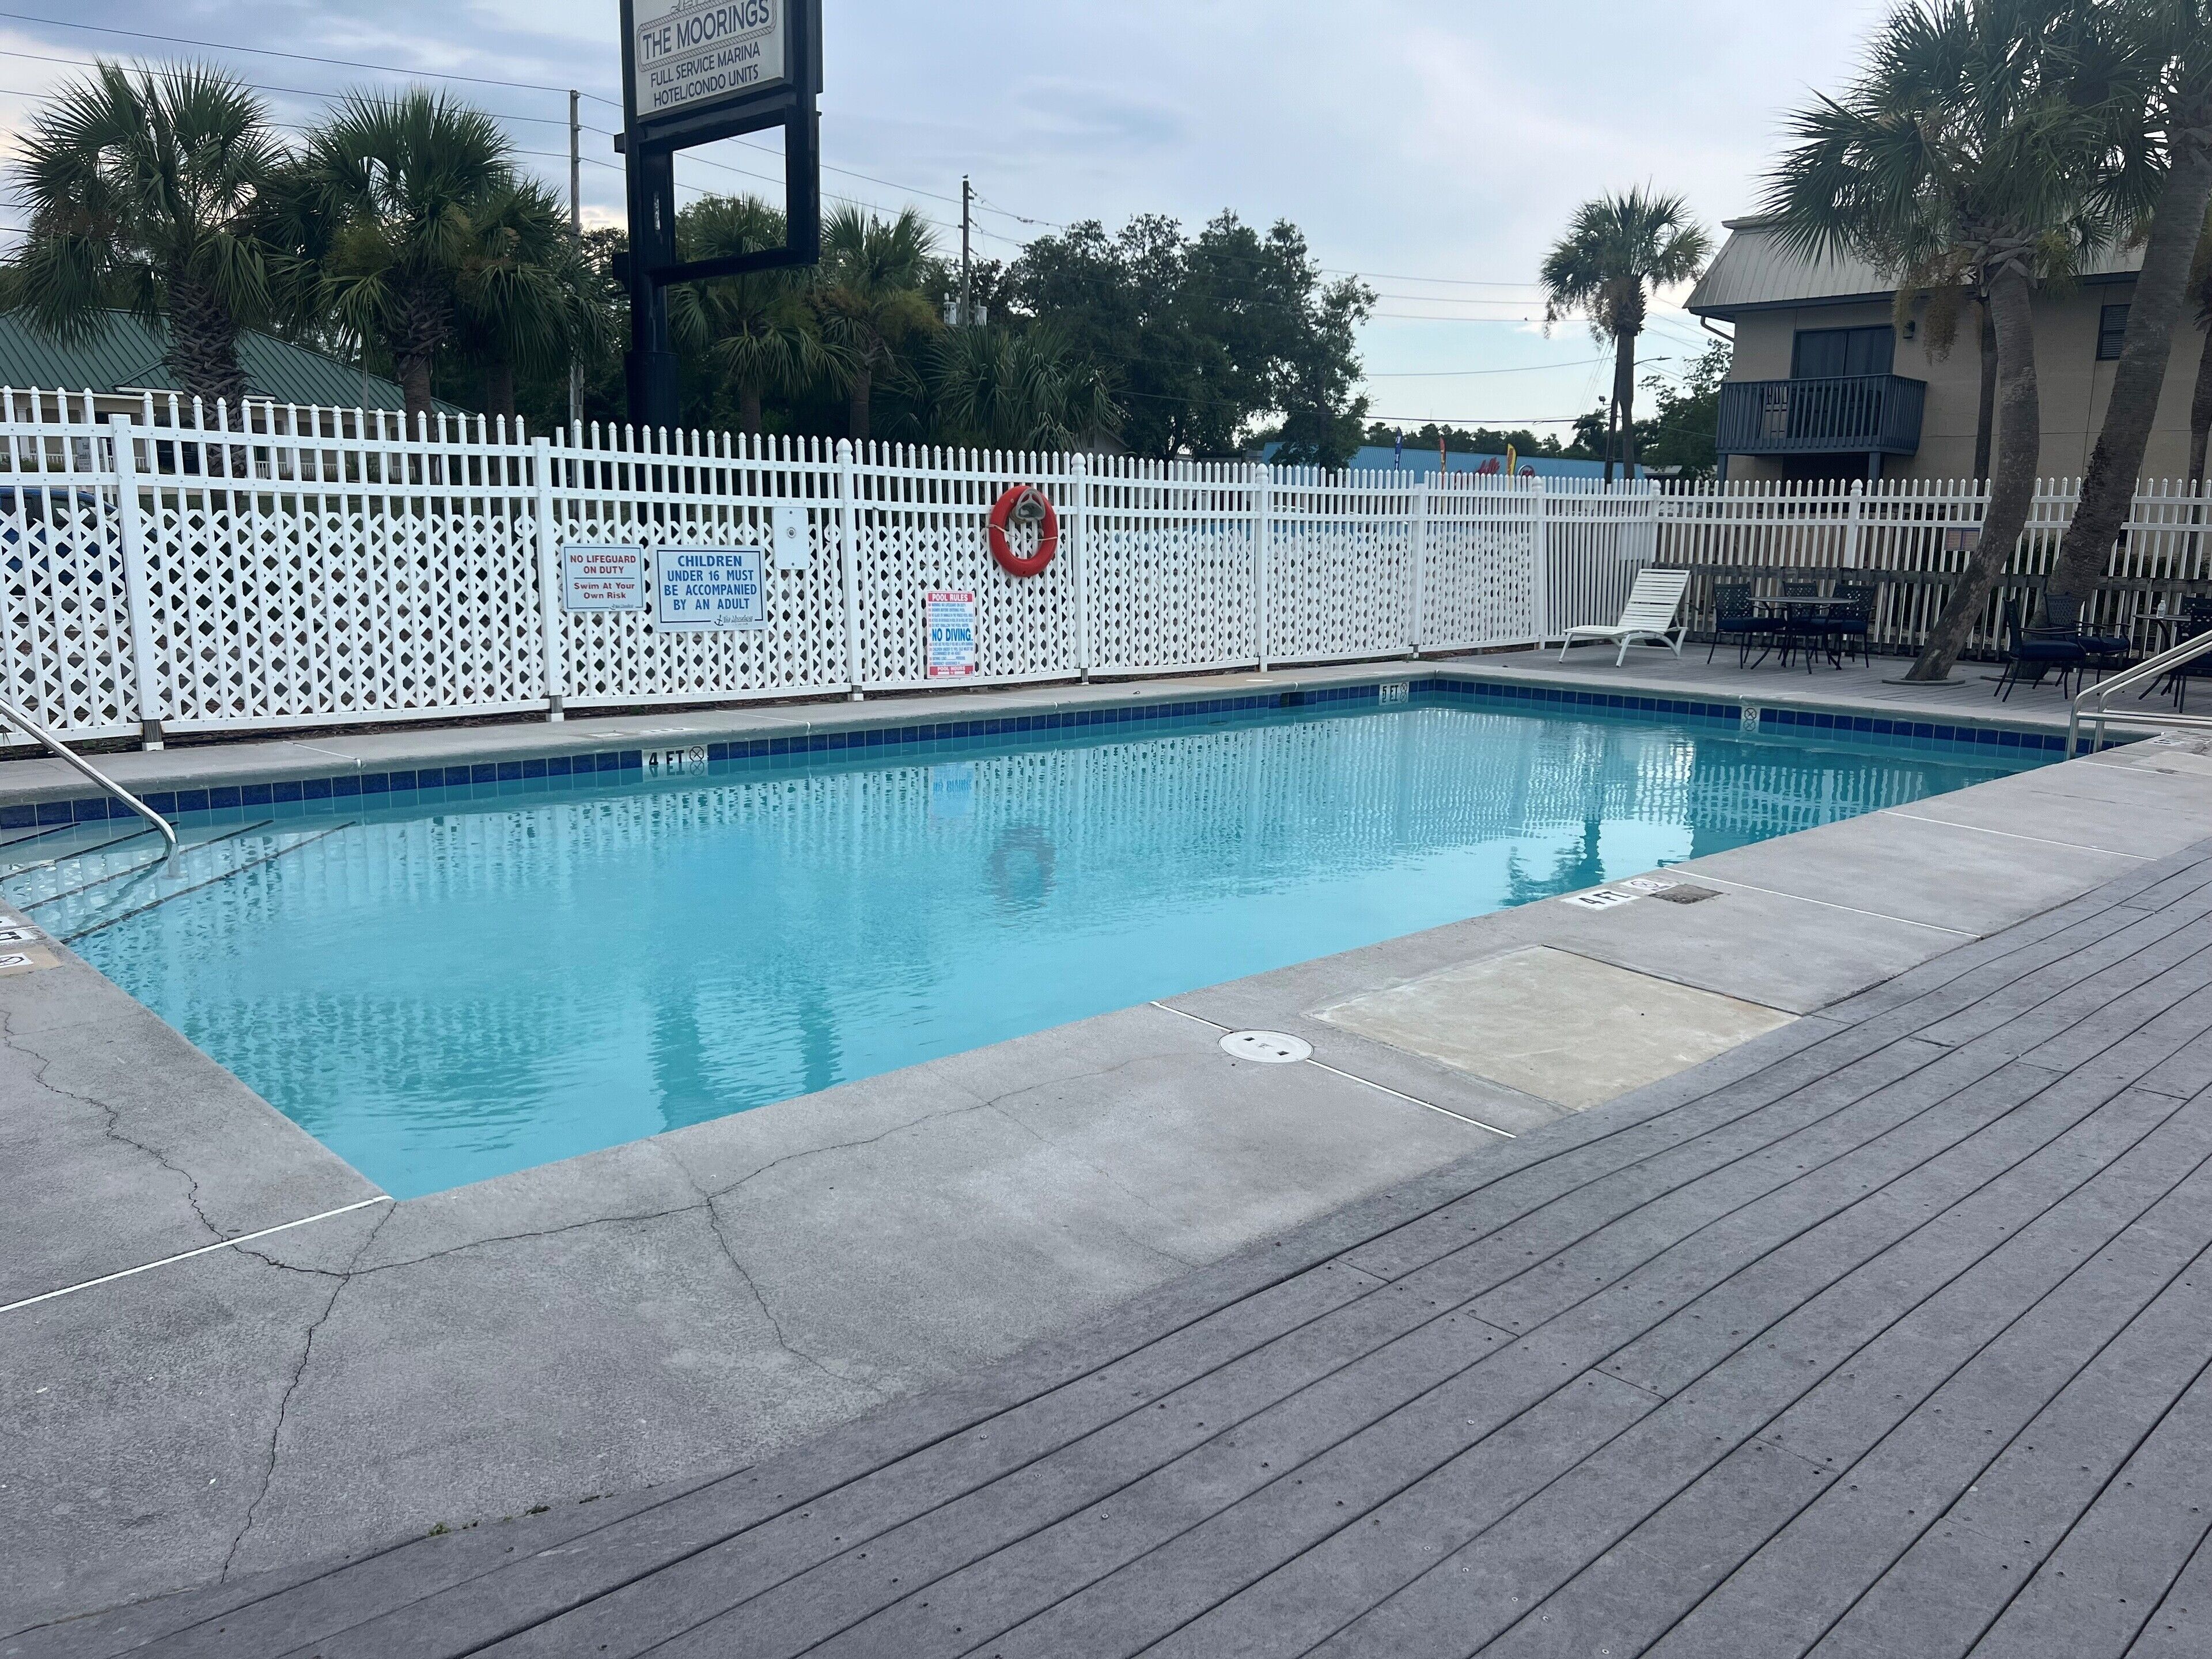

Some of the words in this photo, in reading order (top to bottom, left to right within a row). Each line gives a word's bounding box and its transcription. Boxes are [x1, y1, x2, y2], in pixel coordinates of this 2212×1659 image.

[643, 26, 672, 59] THE
[677, 0, 770, 49] MOORINGS
[651, 70, 674, 88] FULL
[676, 55, 714, 81] SERVICE
[718, 41, 760, 67] MARINA
[654, 73, 726, 107] HOTEL/CONDO
[729, 64, 759, 86] UNITS
[570, 555, 583, 563] NO
[586, 555, 636, 563] LIFEGUARD
[677, 555, 742, 567] CHILDREN
[600, 566, 624, 574] DUTY
[667, 570, 703, 582] UNDER
[709, 570, 719, 581] 16
[727, 570, 754, 581] MUST
[664, 584, 679, 596] BE
[685, 584, 757, 596] ACCOMPANIED
[949, 593, 968, 601] RULES
[673, 599, 686, 610] BY
[695, 599, 710, 610] AN
[717, 598, 750, 609] ADULT
[932, 628, 942, 641] NO
[946, 628, 973, 641] DIVING.
[649, 752, 658, 765] 4
[666, 750, 684, 764] FT
[1593, 891, 1631, 902] FT
